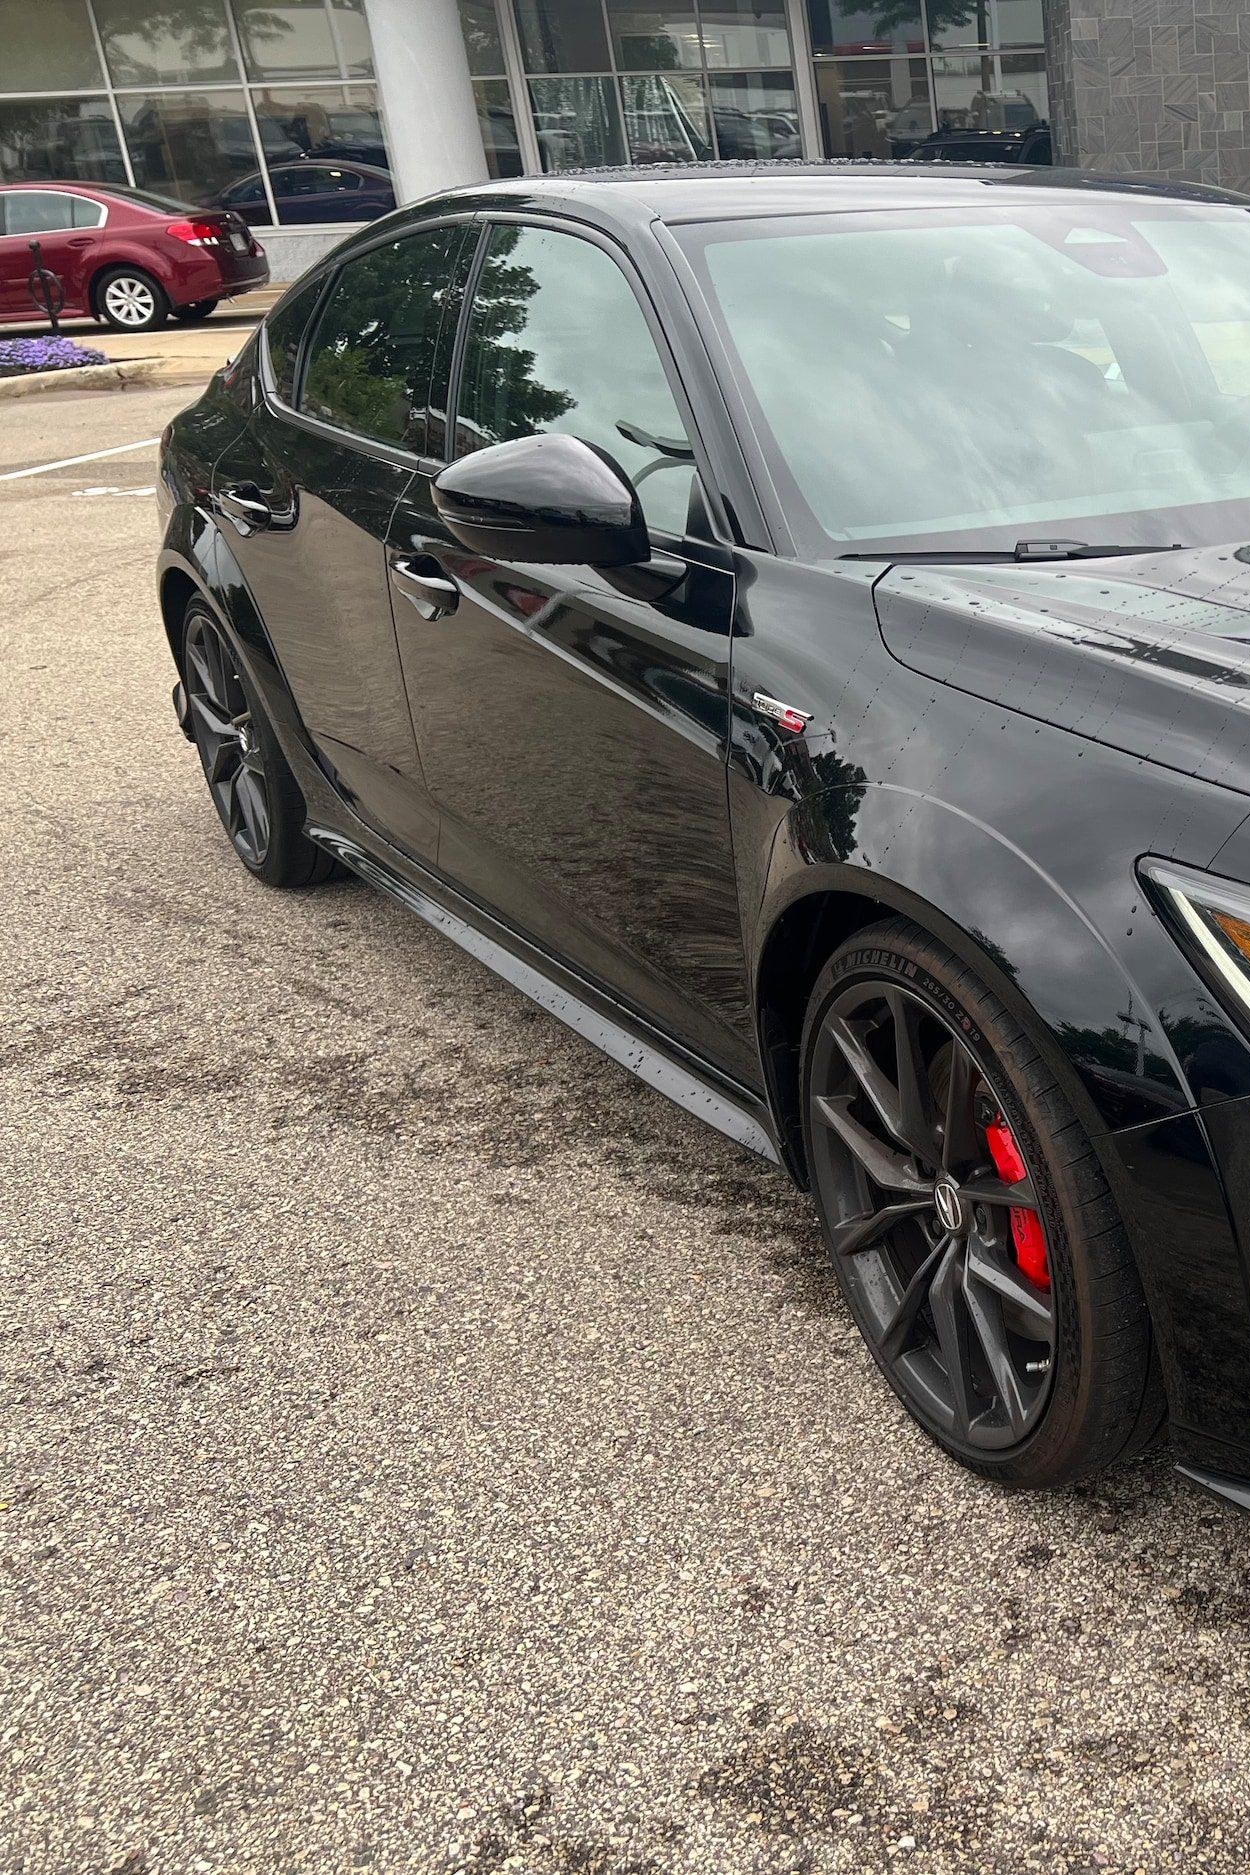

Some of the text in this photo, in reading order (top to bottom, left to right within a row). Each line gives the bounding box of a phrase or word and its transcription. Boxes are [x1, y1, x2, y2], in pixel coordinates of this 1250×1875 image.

[845, 949, 918, 979] MICHELIN
[922, 977, 955, 1010] 265/30
[969, 1028, 981, 1042] 19
